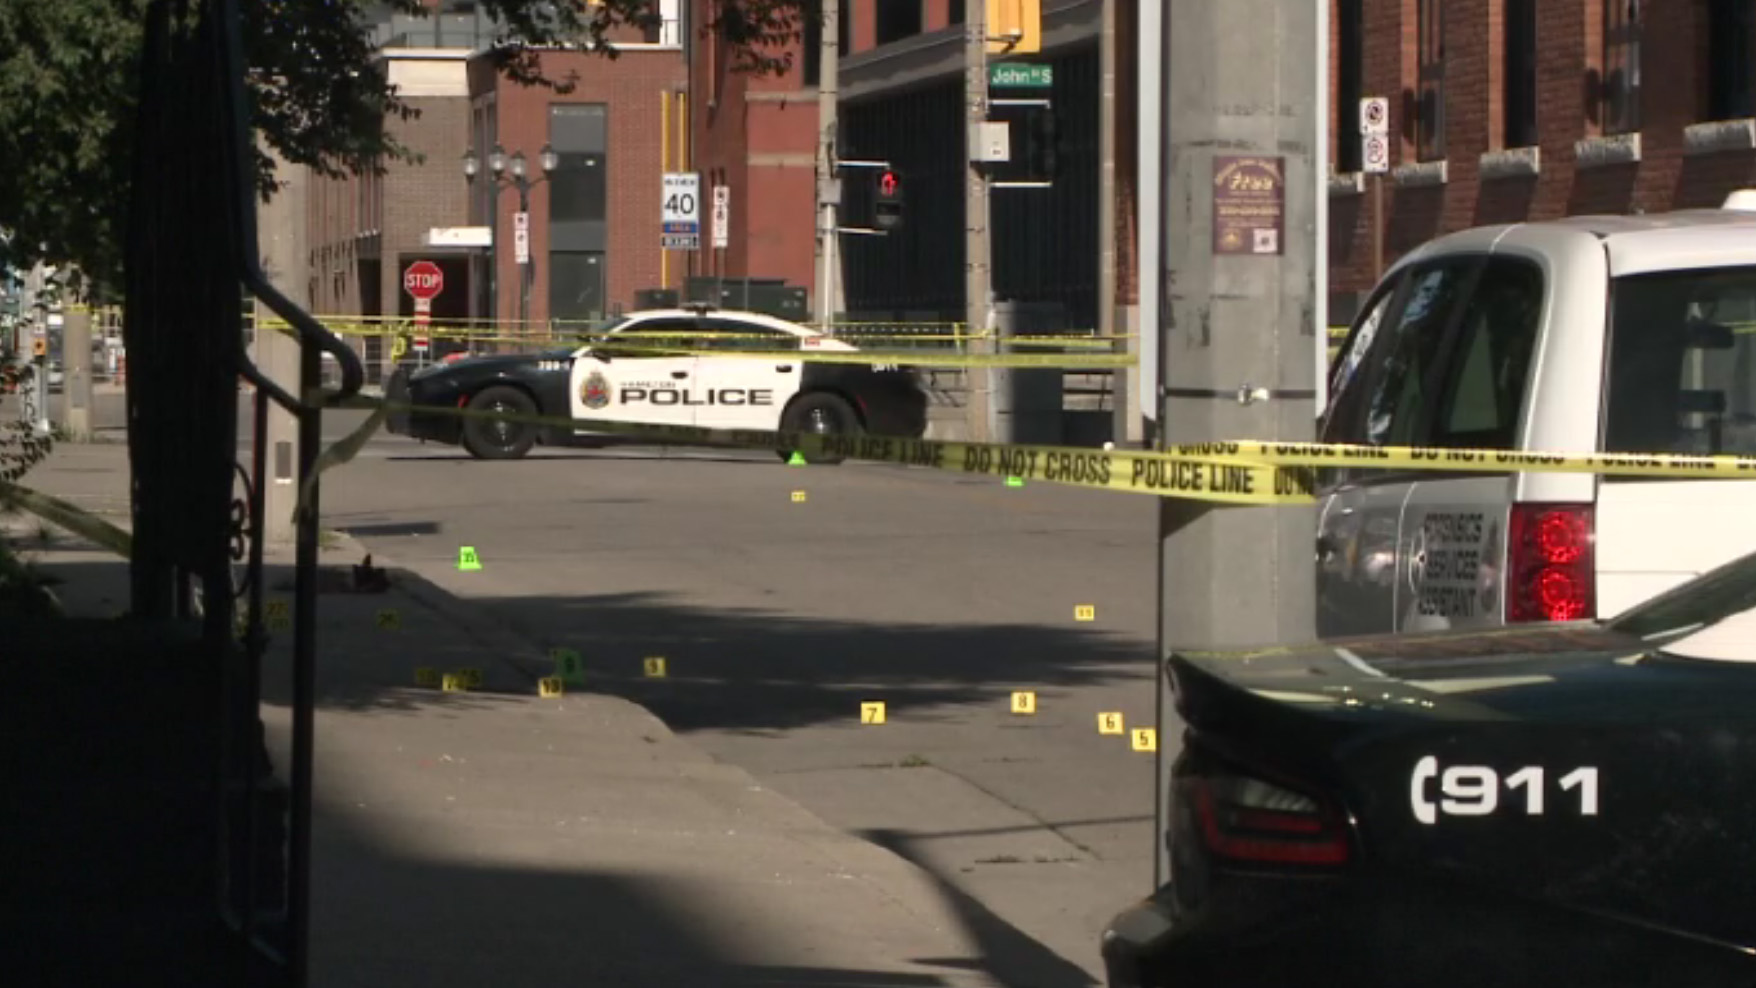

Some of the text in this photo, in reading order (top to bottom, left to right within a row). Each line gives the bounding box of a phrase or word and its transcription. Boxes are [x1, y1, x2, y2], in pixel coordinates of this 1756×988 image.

[992, 69, 1029, 84] John
[1042, 69, 1053, 84] S
[664, 193, 695, 214] 40
[406, 274, 440, 288] STOP
[620, 388, 774, 406] POLICE
[900, 439, 944, 469] LINE
[964, 446, 992, 473] DO
[998, 449, 1038, 479] NOT
[1044, 453, 1111, 484] CROSS
[1131, 458, 1203, 491] POLICE
[1209, 463, 1254, 494] LINE
[1018, 694, 1028, 708] 8
[866, 707, 878, 723] 7
[1106, 715, 1115, 729] 6
[1139, 731, 1149, 746] 5
[1441, 766, 1598, 816] 911
